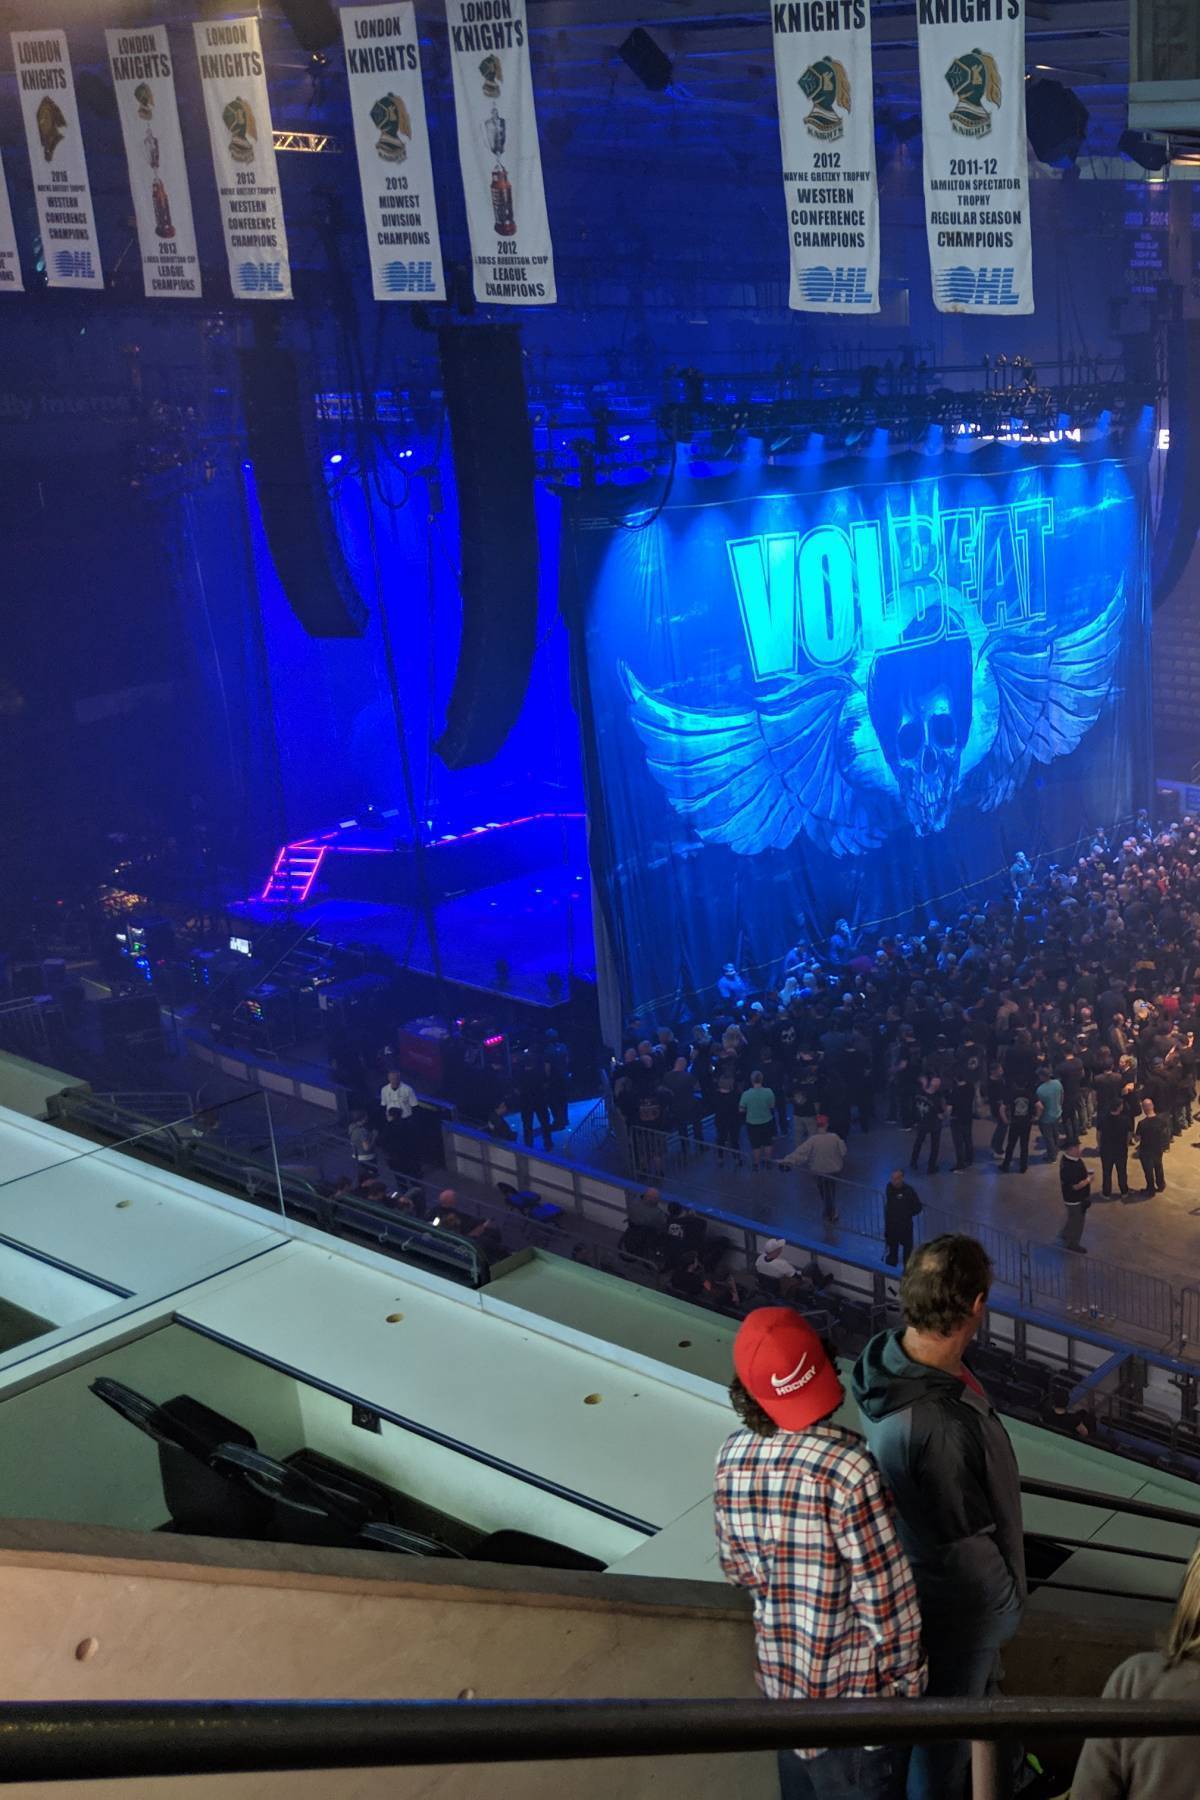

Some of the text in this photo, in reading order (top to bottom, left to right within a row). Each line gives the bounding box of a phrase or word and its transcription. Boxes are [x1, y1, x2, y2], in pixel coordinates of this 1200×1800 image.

[460, 0, 512, 23] LONDON
[774, 0, 867, 34] KNIGHTS
[919, 0, 1020, 25] KNIGHTS
[206, 24, 248, 46] LONDON
[354, 16, 402, 40] LONDON
[451, 19, 524, 53] KNIGHTS
[17, 40, 62, 64] LONDON
[117, 35, 157, 55] LONDON
[111, 53, 171, 81] KNIGHTS
[201, 51, 263, 80] KNIGHTS
[348, 44, 418, 75] KNIGHTS
[20, 68, 67, 91] KNIGHTS
[813, 152, 841, 169] 2012
[949, 158, 998, 176] 2011-12
[236, 172, 256, 185] 2013
[386, 177, 409, 190] 2013
[784, 171, 871, 182] WAYNE GRETZKY TROPHY
[973, 178, 1021, 191] SPECTATOR
[46, 196, 79, 208] WESTERN
[378, 194, 420, 209] MIDWEST
[797, 187, 854, 204] WESTERN
[957, 195, 990, 207] TROPHY
[229, 199, 267, 213] WESTERN
[45, 212, 87, 225] CONFERENCE
[228, 217, 277, 231] CONFERENCE
[381, 212, 422, 228] DIVISION
[791, 209, 866, 226] CONFERENCE
[931, 211, 1022, 225] REGULAR SEASON
[49, 227, 89, 240] CHAMPIONS
[231, 234, 278, 247] CHAMPIONS
[377, 231, 431, 246] CHAMPIONS
[793, 231, 866, 248] CHAMPIONS
[937, 231, 1014, 249] CHAMPIONS
[497, 240, 518, 255] 2012
[531, 255, 549, 265] CUP
[158, 265, 185, 277] LEAGUE
[235, 261, 284, 292] OHL
[378, 259, 436, 293] OHL
[493, 267, 528, 281] LEAGUE
[151, 279, 196, 291] CHAMPIONS
[485, 282, 546, 298] CHAMPIONS
[798, 265, 873, 304] OHL
[936, 266, 1020, 305] OHL
[727, 498, 1055, 683] VOLBEAT
[776, 1365, 817, 1396] HOCKEY
